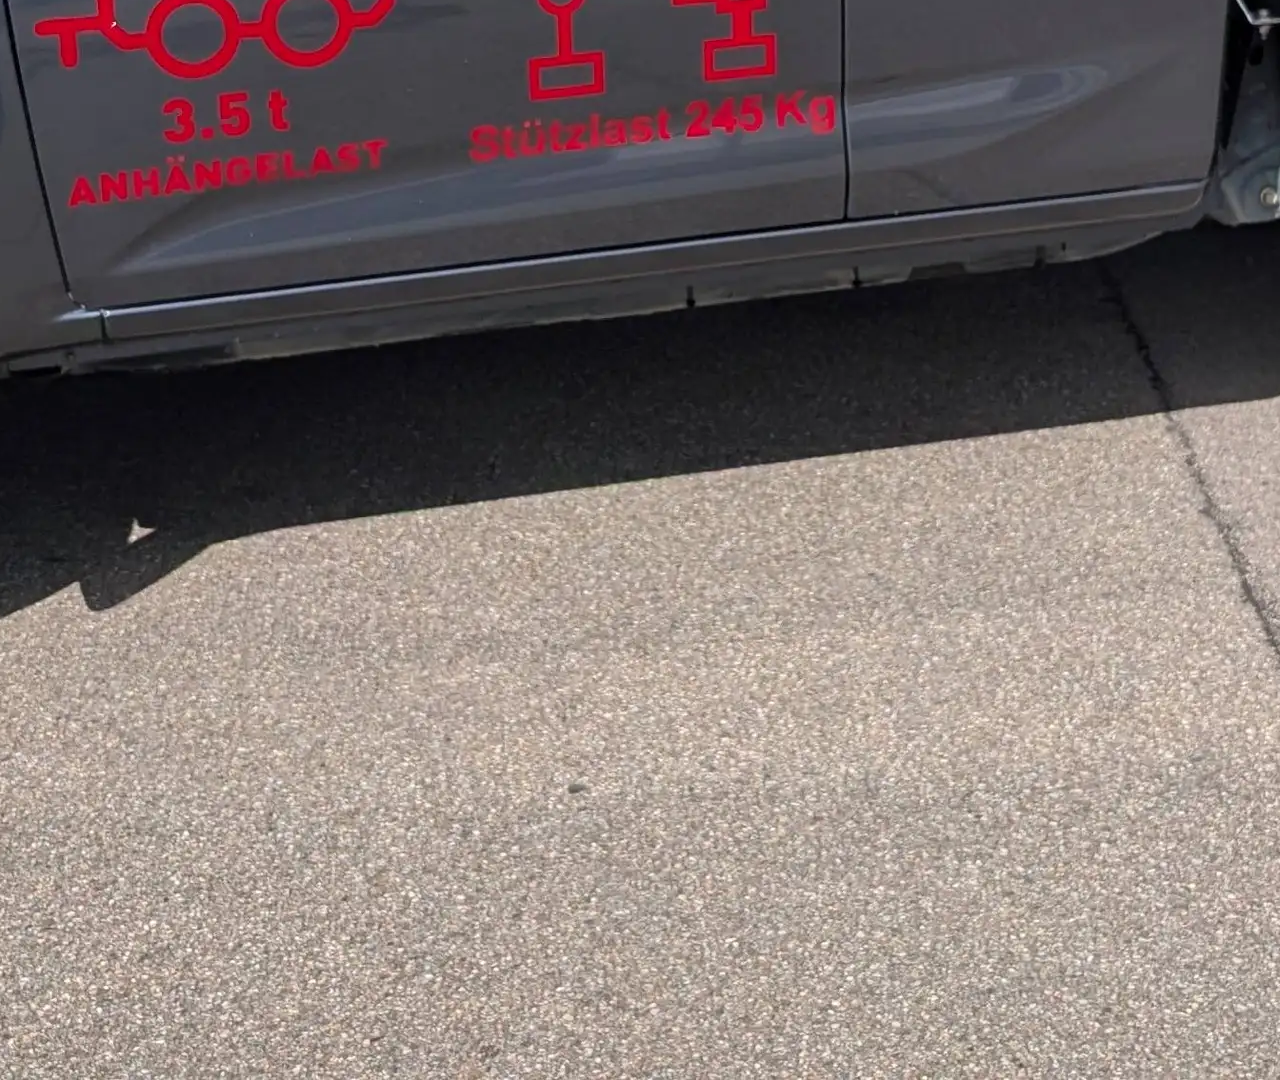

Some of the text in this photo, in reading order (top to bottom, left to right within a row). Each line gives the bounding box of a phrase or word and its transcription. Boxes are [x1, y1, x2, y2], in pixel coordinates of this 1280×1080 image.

[162, 89, 291, 144] 3.5 t
[467, 89, 837, 164] Stützlast 245 Kg
[68, 138, 388, 208] ANHÄNGELAST
